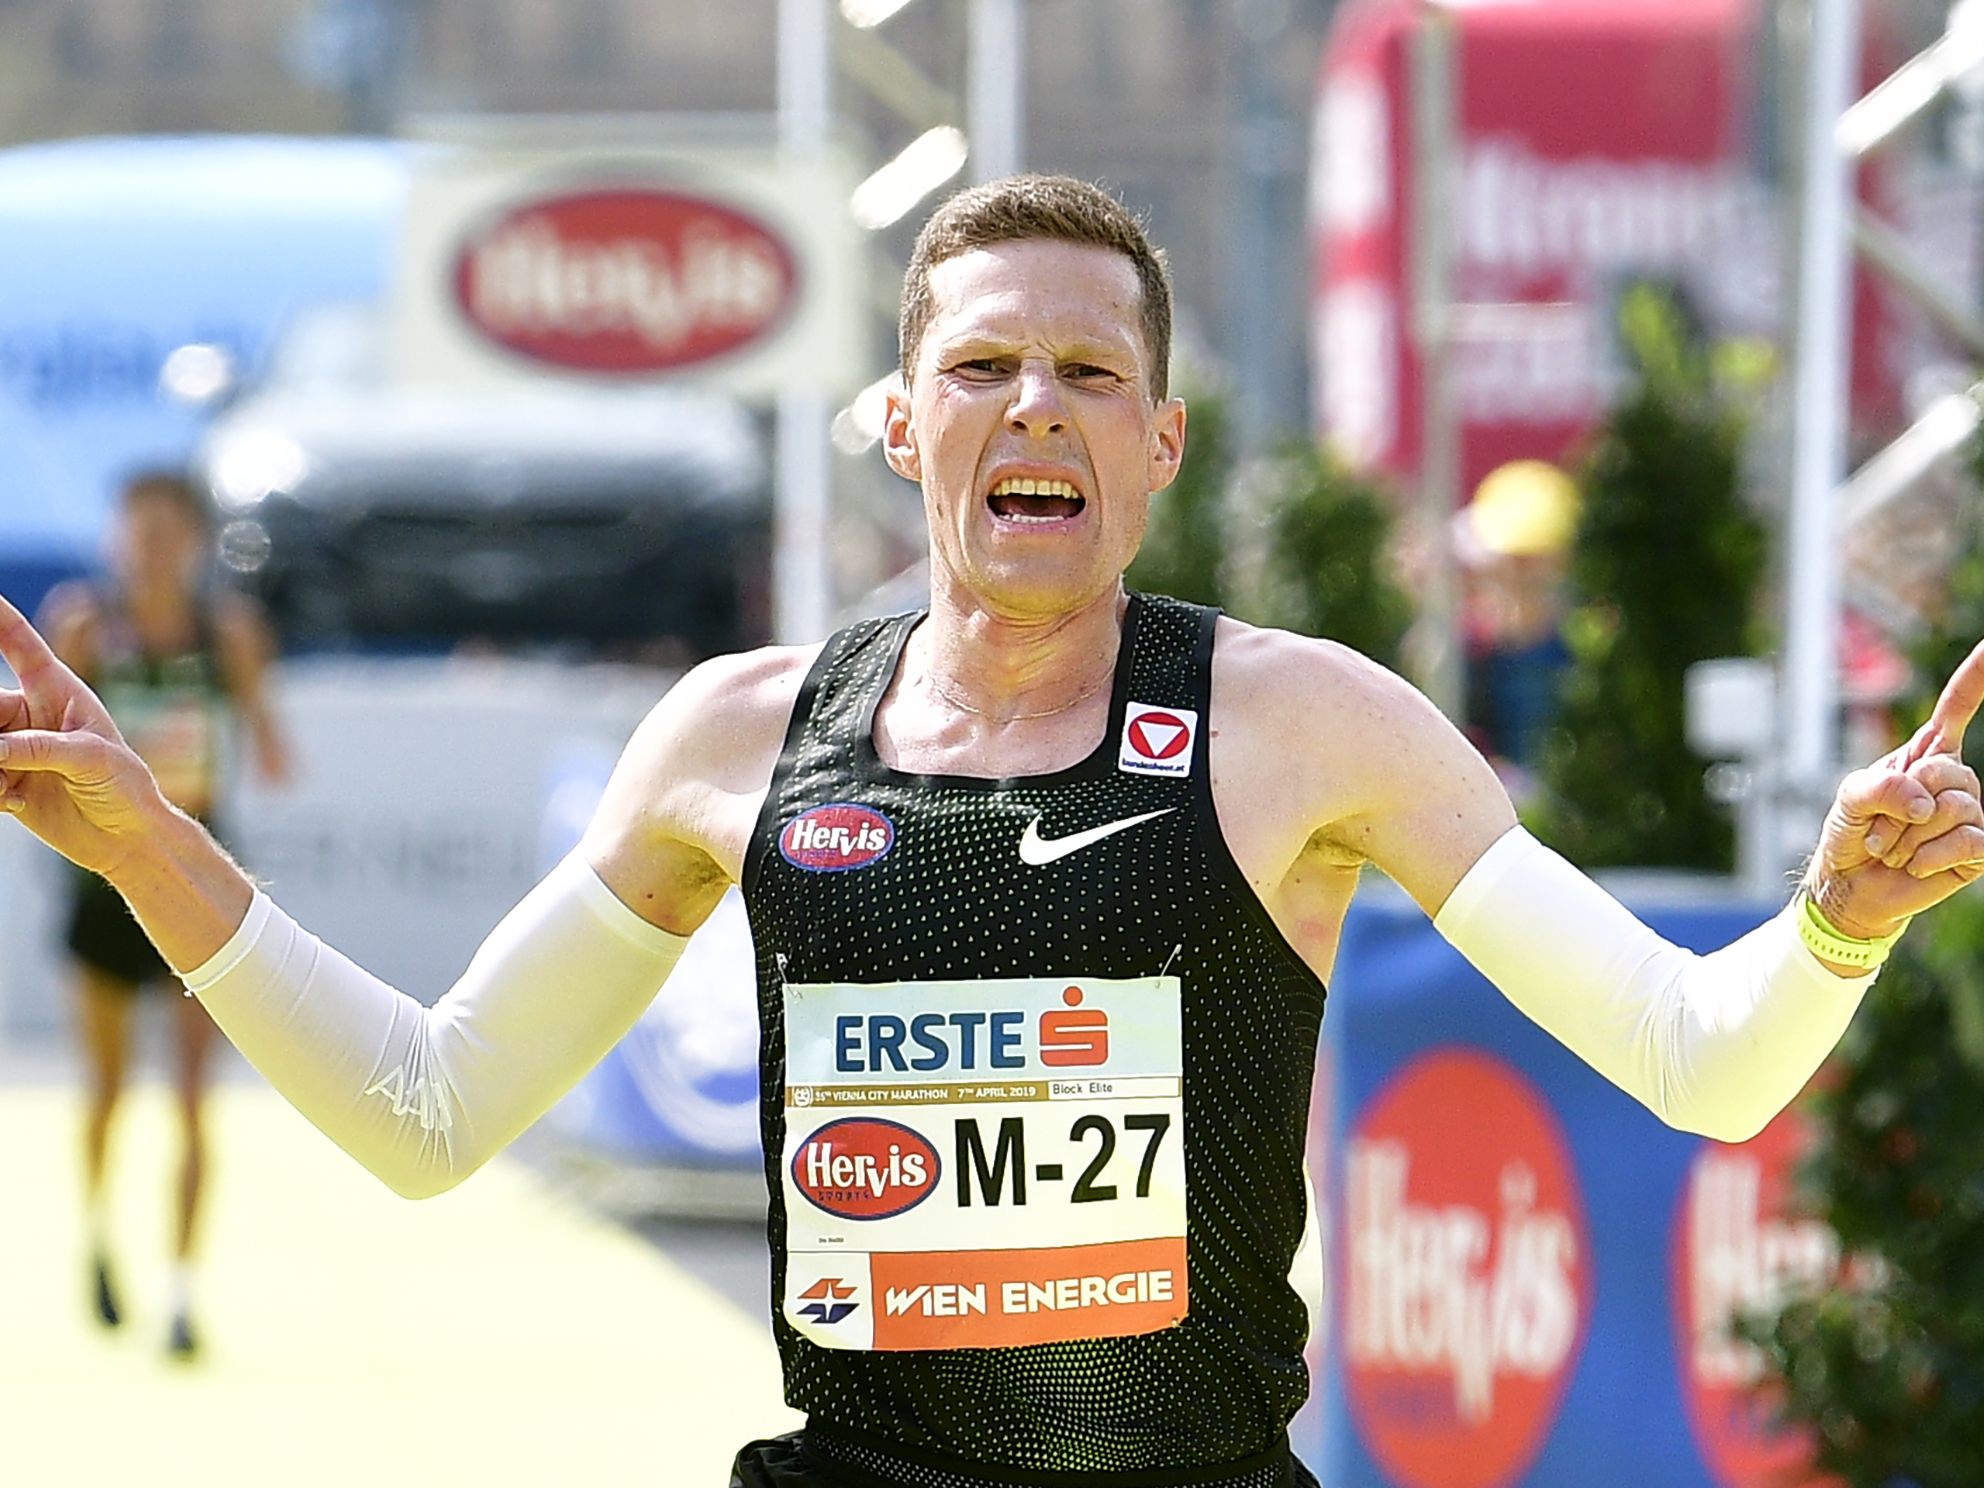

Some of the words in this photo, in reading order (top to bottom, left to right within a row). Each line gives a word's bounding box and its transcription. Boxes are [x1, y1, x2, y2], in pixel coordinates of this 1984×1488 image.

[790, 818, 887, 857] Hervis
[835, 1012, 1026, 1073] ERSTE
[833, 1090, 867, 1102] VIENNA
[867, 1090, 890, 1100] CITY
[890, 1088, 949, 1100] MARATHON
[975, 1086, 1008, 1097] APRIL
[1009, 1085, 1037, 1096] 2019
[1052, 1083, 1083, 1095] Block
[1089, 1082, 1113, 1093] Elite
[806, 1141, 928, 1198] Hervis
[954, 1113, 1171, 1208] M-27
[885, 1283, 987, 1317] WIEN
[1001, 1270, 1174, 1315] ENERGIE
